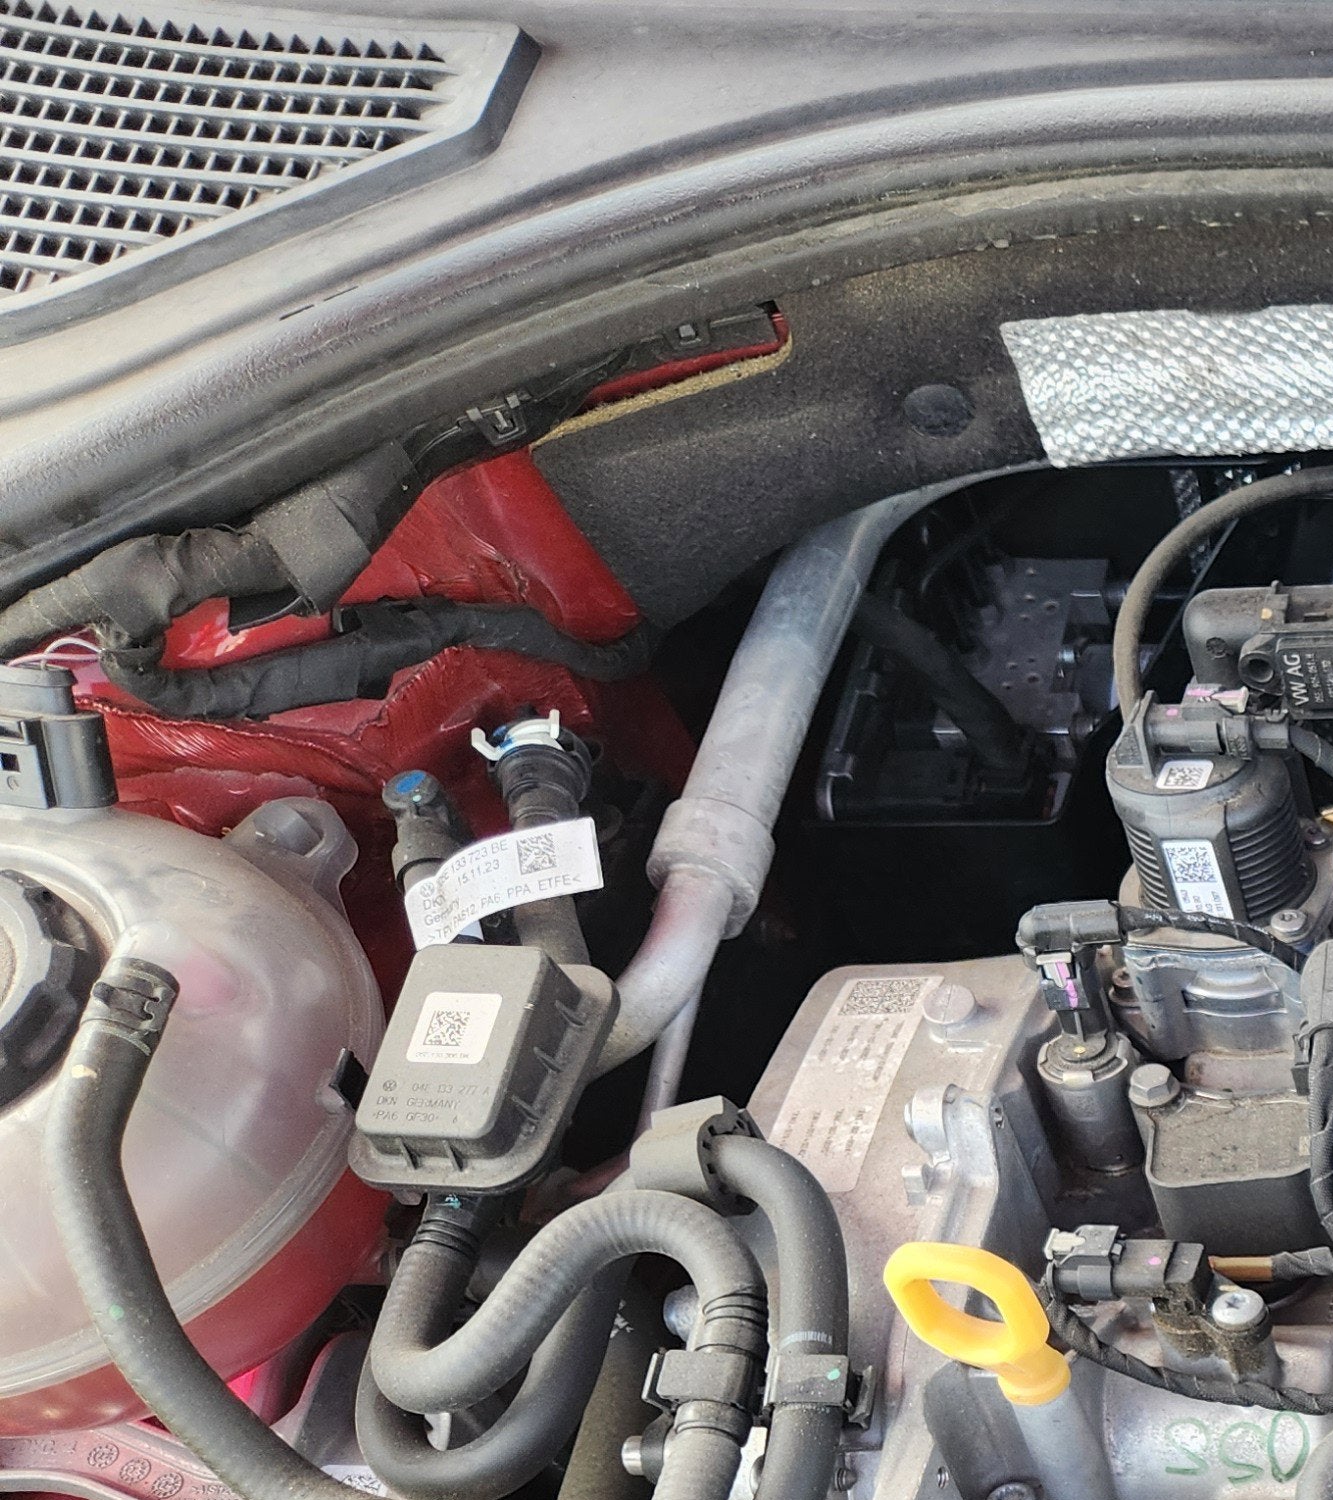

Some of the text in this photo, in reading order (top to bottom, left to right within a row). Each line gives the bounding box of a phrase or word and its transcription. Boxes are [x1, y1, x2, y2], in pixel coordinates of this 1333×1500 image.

[1283, 654, 1309, 706] VW AG
[468, 847, 488, 865] 723
[491, 839, 509, 855] BE
